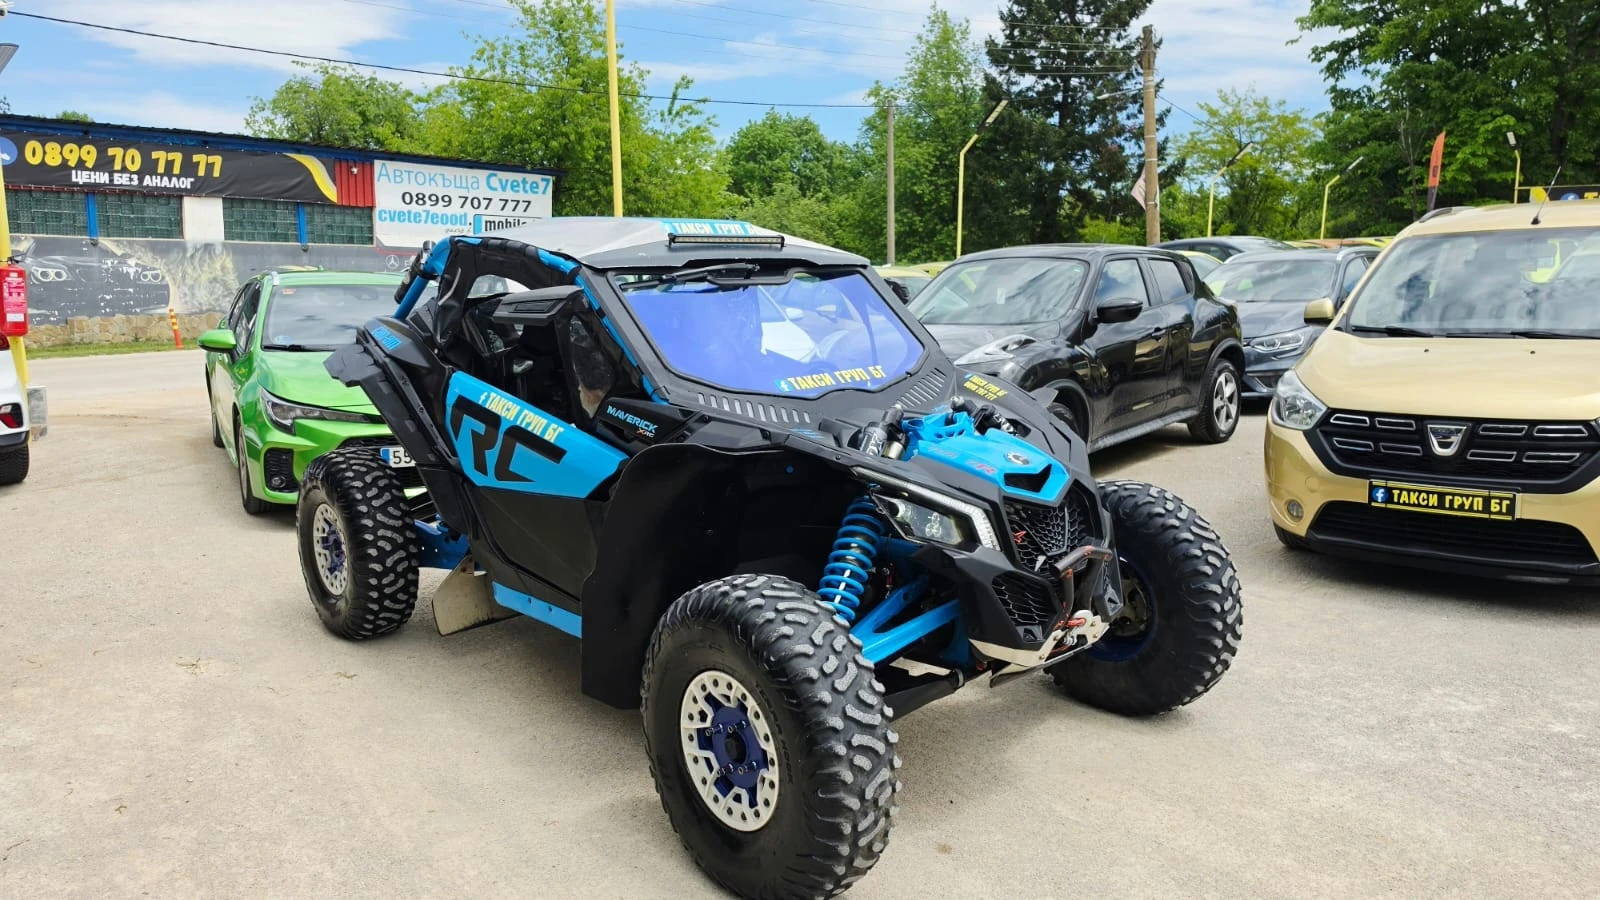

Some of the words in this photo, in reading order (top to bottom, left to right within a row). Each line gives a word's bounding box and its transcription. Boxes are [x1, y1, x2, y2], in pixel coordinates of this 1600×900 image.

[24, 140, 98, 169] 0899
[107, 147, 142, 172] 70
[151, 150, 183, 175] 77
[192, 153, 223, 178] 77
[71, 169, 110, 185] ЦЕНИ
[113, 172, 139, 187] БЕЗ
[142, 175, 195, 189] АНАЛОГ
[485, 172, 551, 195] Cvete7
[401, 191, 452, 207] 0899
[458, 195, 494, 210] 707
[499, 198, 532, 213] 777
[672, 222, 711, 236] ТАКСИ
[714, 223, 743, 236] ГРУП
[786, 372, 836, 391] ТАКСИ
[833, 367, 871, 384] ГРУП
[867, 365, 887, 379] БГ
[485, 391, 519, 422] ТАКСИ
[516, 408, 548, 434] ГРУП
[543, 422, 565, 443] БГ
[606, 405, 659, 433] MAVERICK
[1392, 490, 1438, 507] ТАКСИ
[1444, 495, 1483, 511] ГРУП
[1490, 499, 1511, 513] БГ
